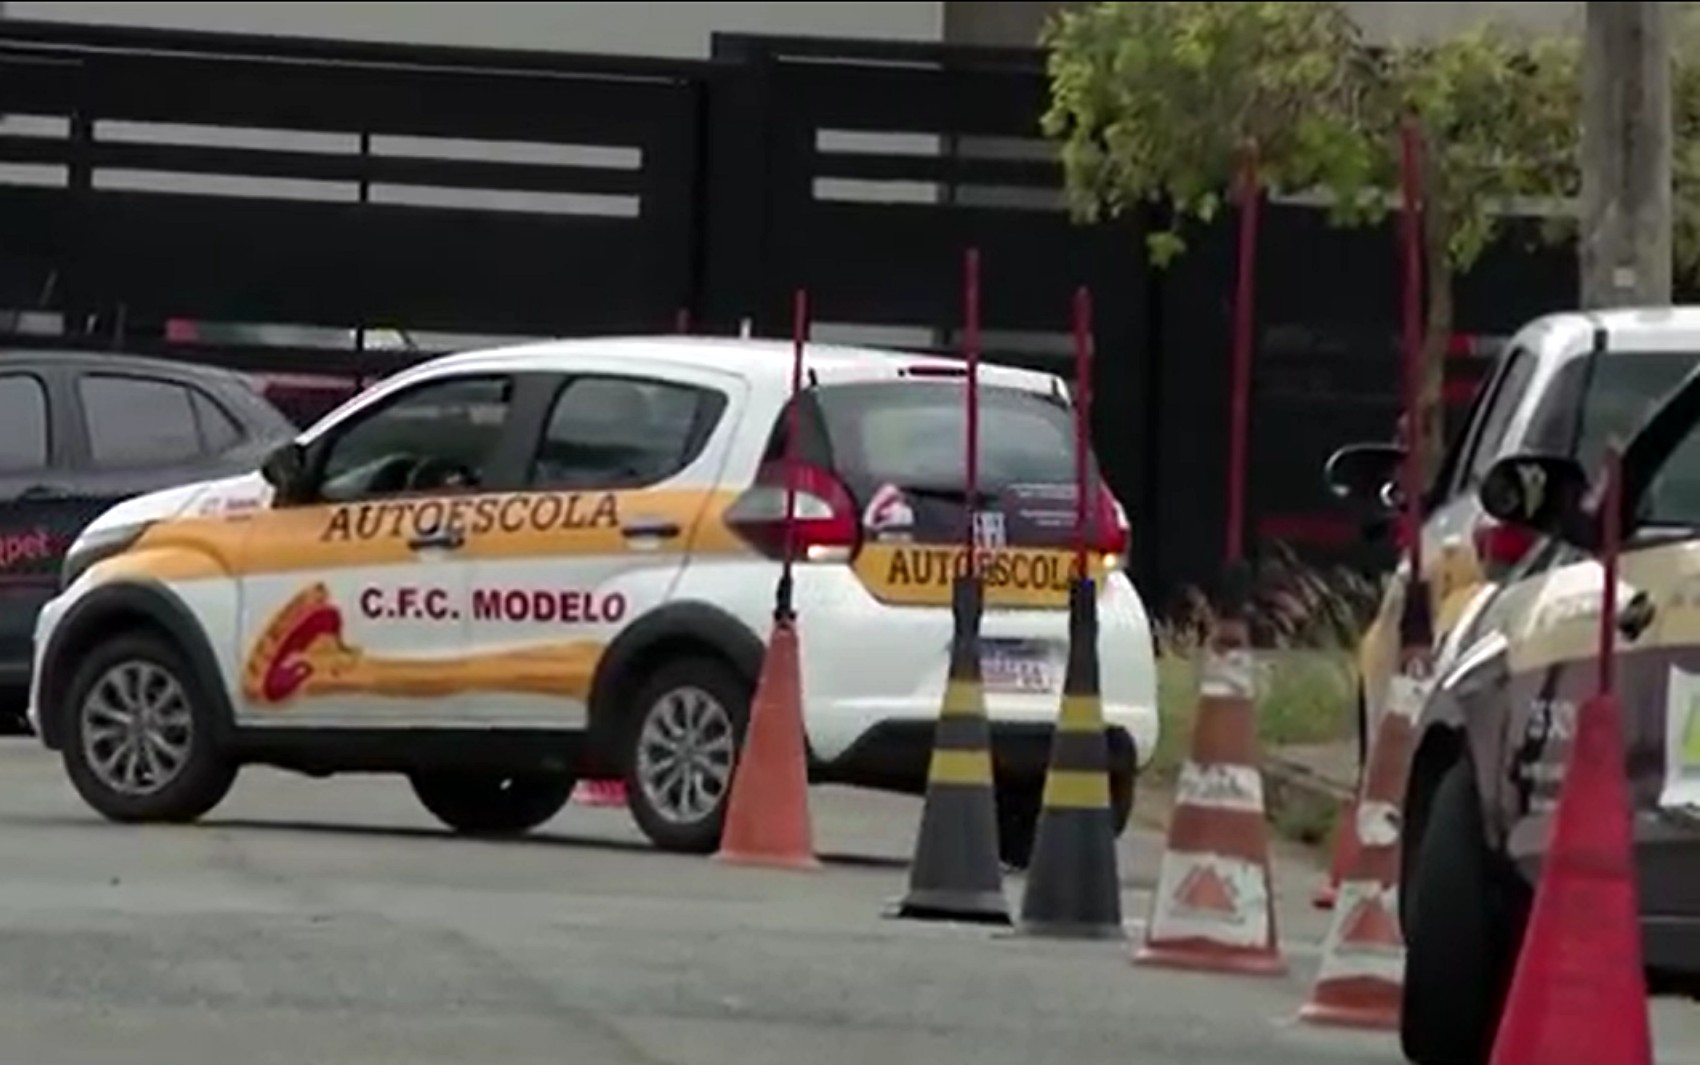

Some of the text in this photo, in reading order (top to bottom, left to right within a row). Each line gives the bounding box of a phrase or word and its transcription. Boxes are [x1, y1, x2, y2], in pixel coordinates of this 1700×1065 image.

[320, 494, 620, 541] AUTOESCOLA
[360, 588, 626, 623] C.F.C. MODELO
